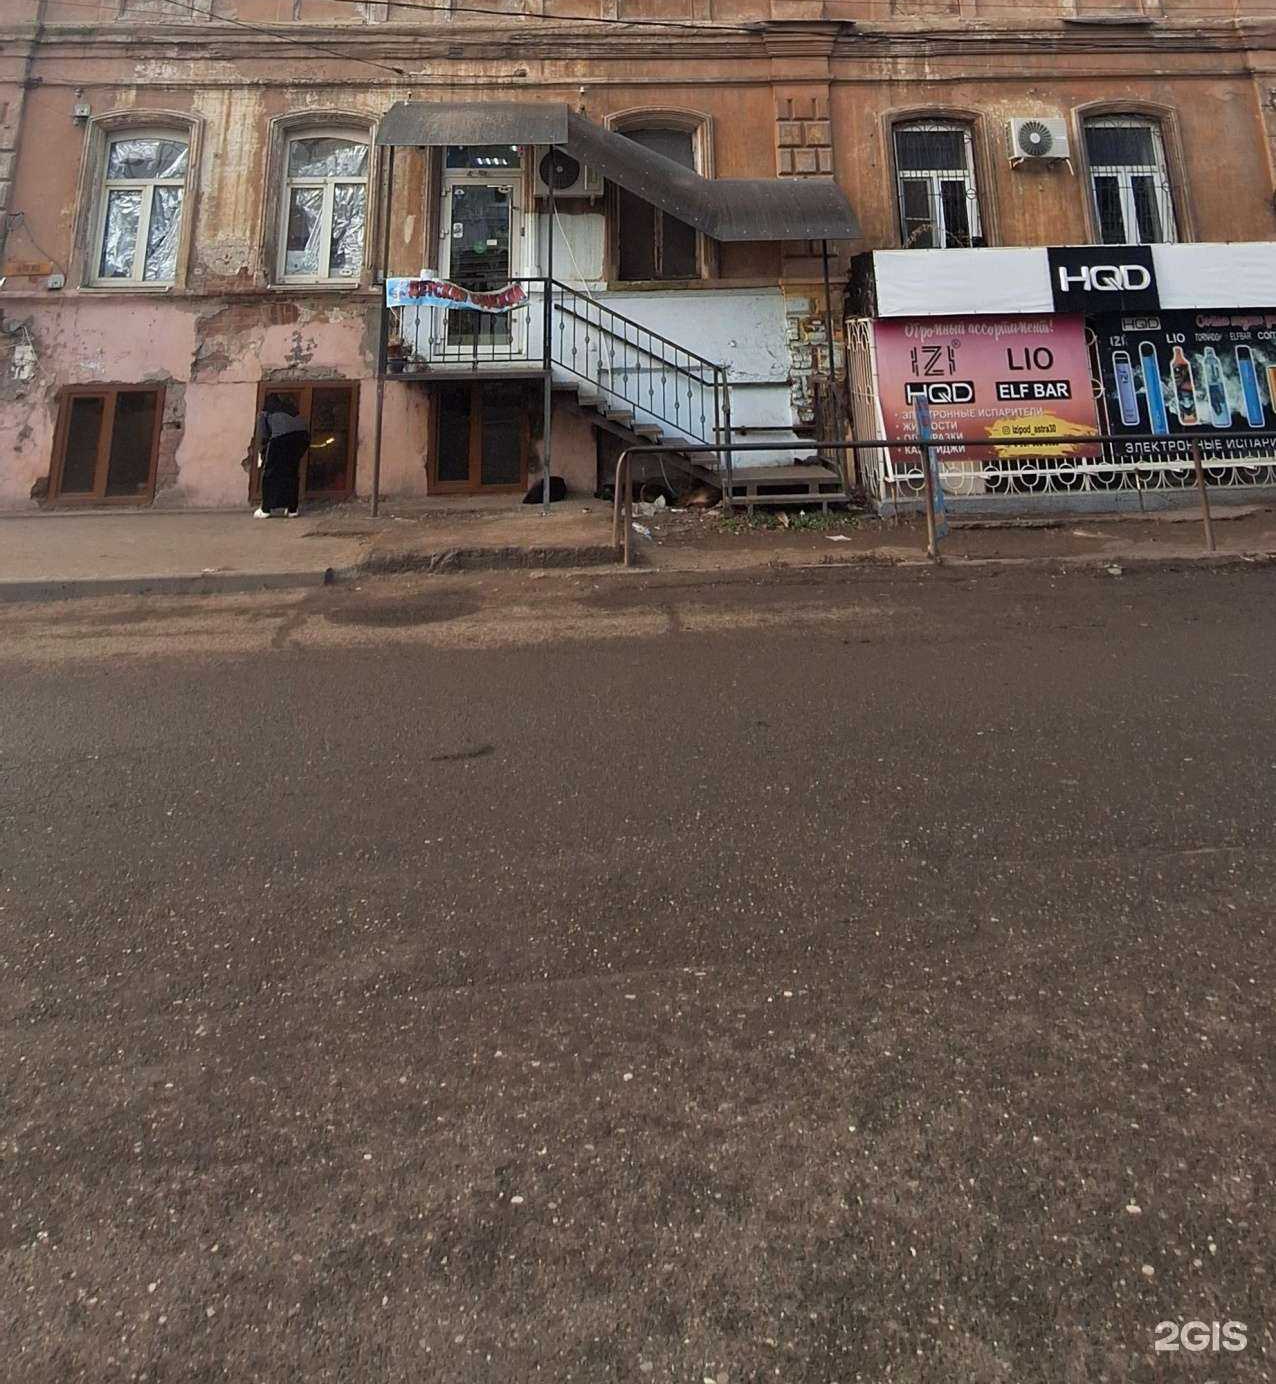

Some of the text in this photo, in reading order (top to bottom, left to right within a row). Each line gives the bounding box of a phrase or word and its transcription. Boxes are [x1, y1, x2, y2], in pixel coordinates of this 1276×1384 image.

[1059, 265, 1151, 292] HQD
[1166, 333, 1186, 344] LIO
[1007, 347, 1054, 370] LIO
[906, 383, 973, 404] HQD
[999, 382, 1069, 399] ELF BAR
[979, 407, 1044, 418] ИСПАРИТЕЛИ
[902, 422, 958, 432] ЖИОСТИ
